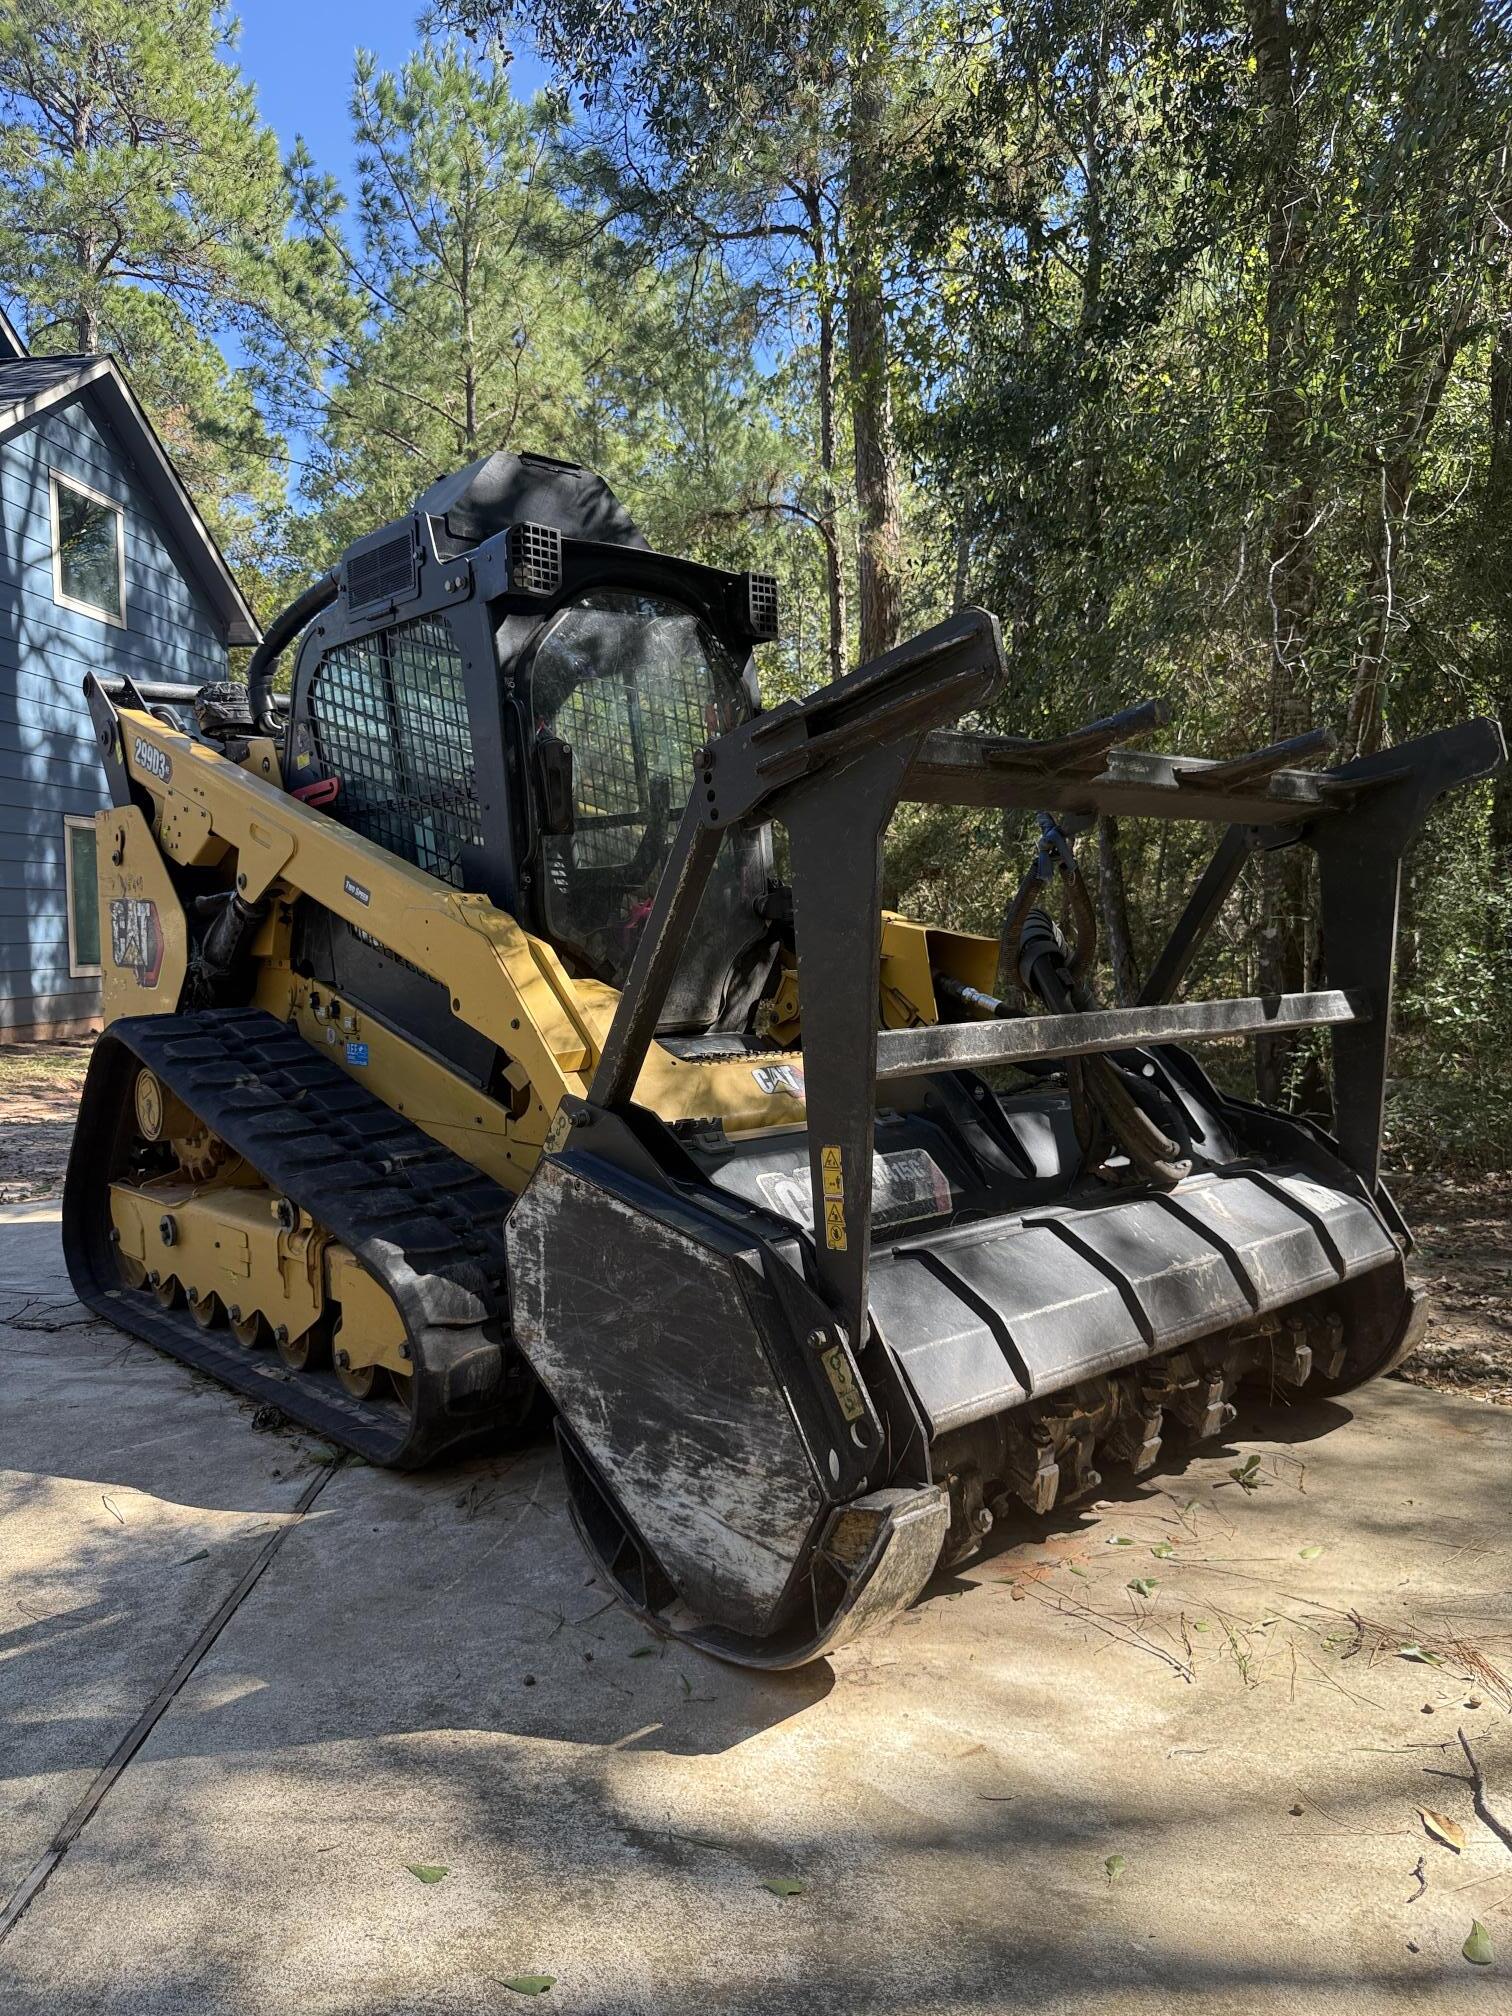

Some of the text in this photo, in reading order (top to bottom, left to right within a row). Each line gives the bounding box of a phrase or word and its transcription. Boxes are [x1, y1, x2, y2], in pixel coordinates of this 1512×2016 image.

[135, 737, 167, 779] 299D3
[111, 900, 151, 966] CAT
[752, 1066, 800, 1094] CAT
